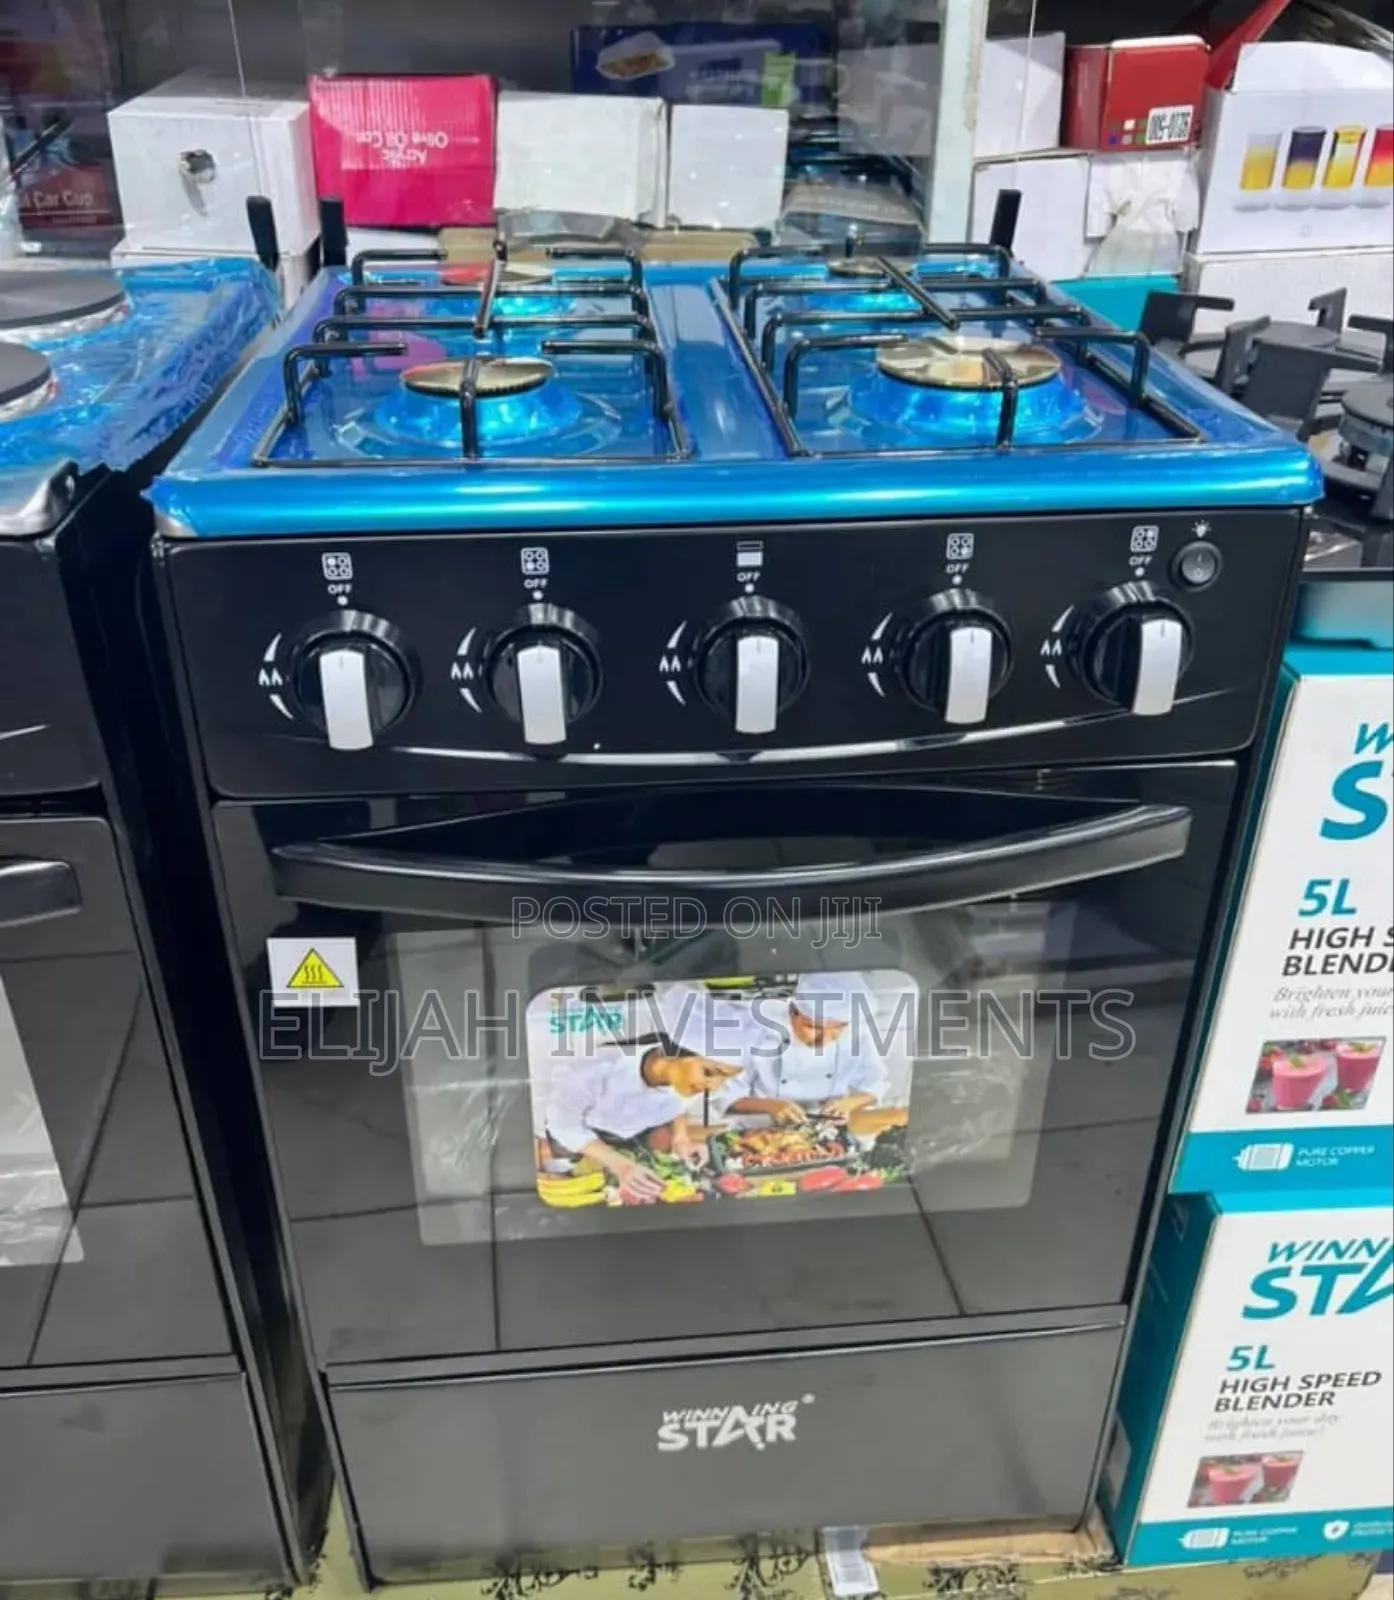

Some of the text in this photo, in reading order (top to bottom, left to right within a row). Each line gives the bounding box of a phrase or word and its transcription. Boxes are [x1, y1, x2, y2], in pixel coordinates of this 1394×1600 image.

[33, 189, 59, 210] Car
[62, 189, 94, 208] Cup
[946, 563, 970, 574] OFF
[1128, 555, 1152, 566] OFF
[524, 578, 548, 588] OFF
[736, 571, 761, 582] OFF
[327, 583, 352, 594] OFF
[1319, 760, 1393, 841] S
[1298, 878, 1357, 917] 5L
[1288, 926, 1376, 950] HIGH
[549, 1005, 624, 1034] STAR
[1227, 1344, 1275, 1372] 5L
[1220, 1370, 1382, 1395] HIGH SPEED
[1214, 1391, 1336, 1413] BLENDER
[657, 1405, 797, 1451] STAR
